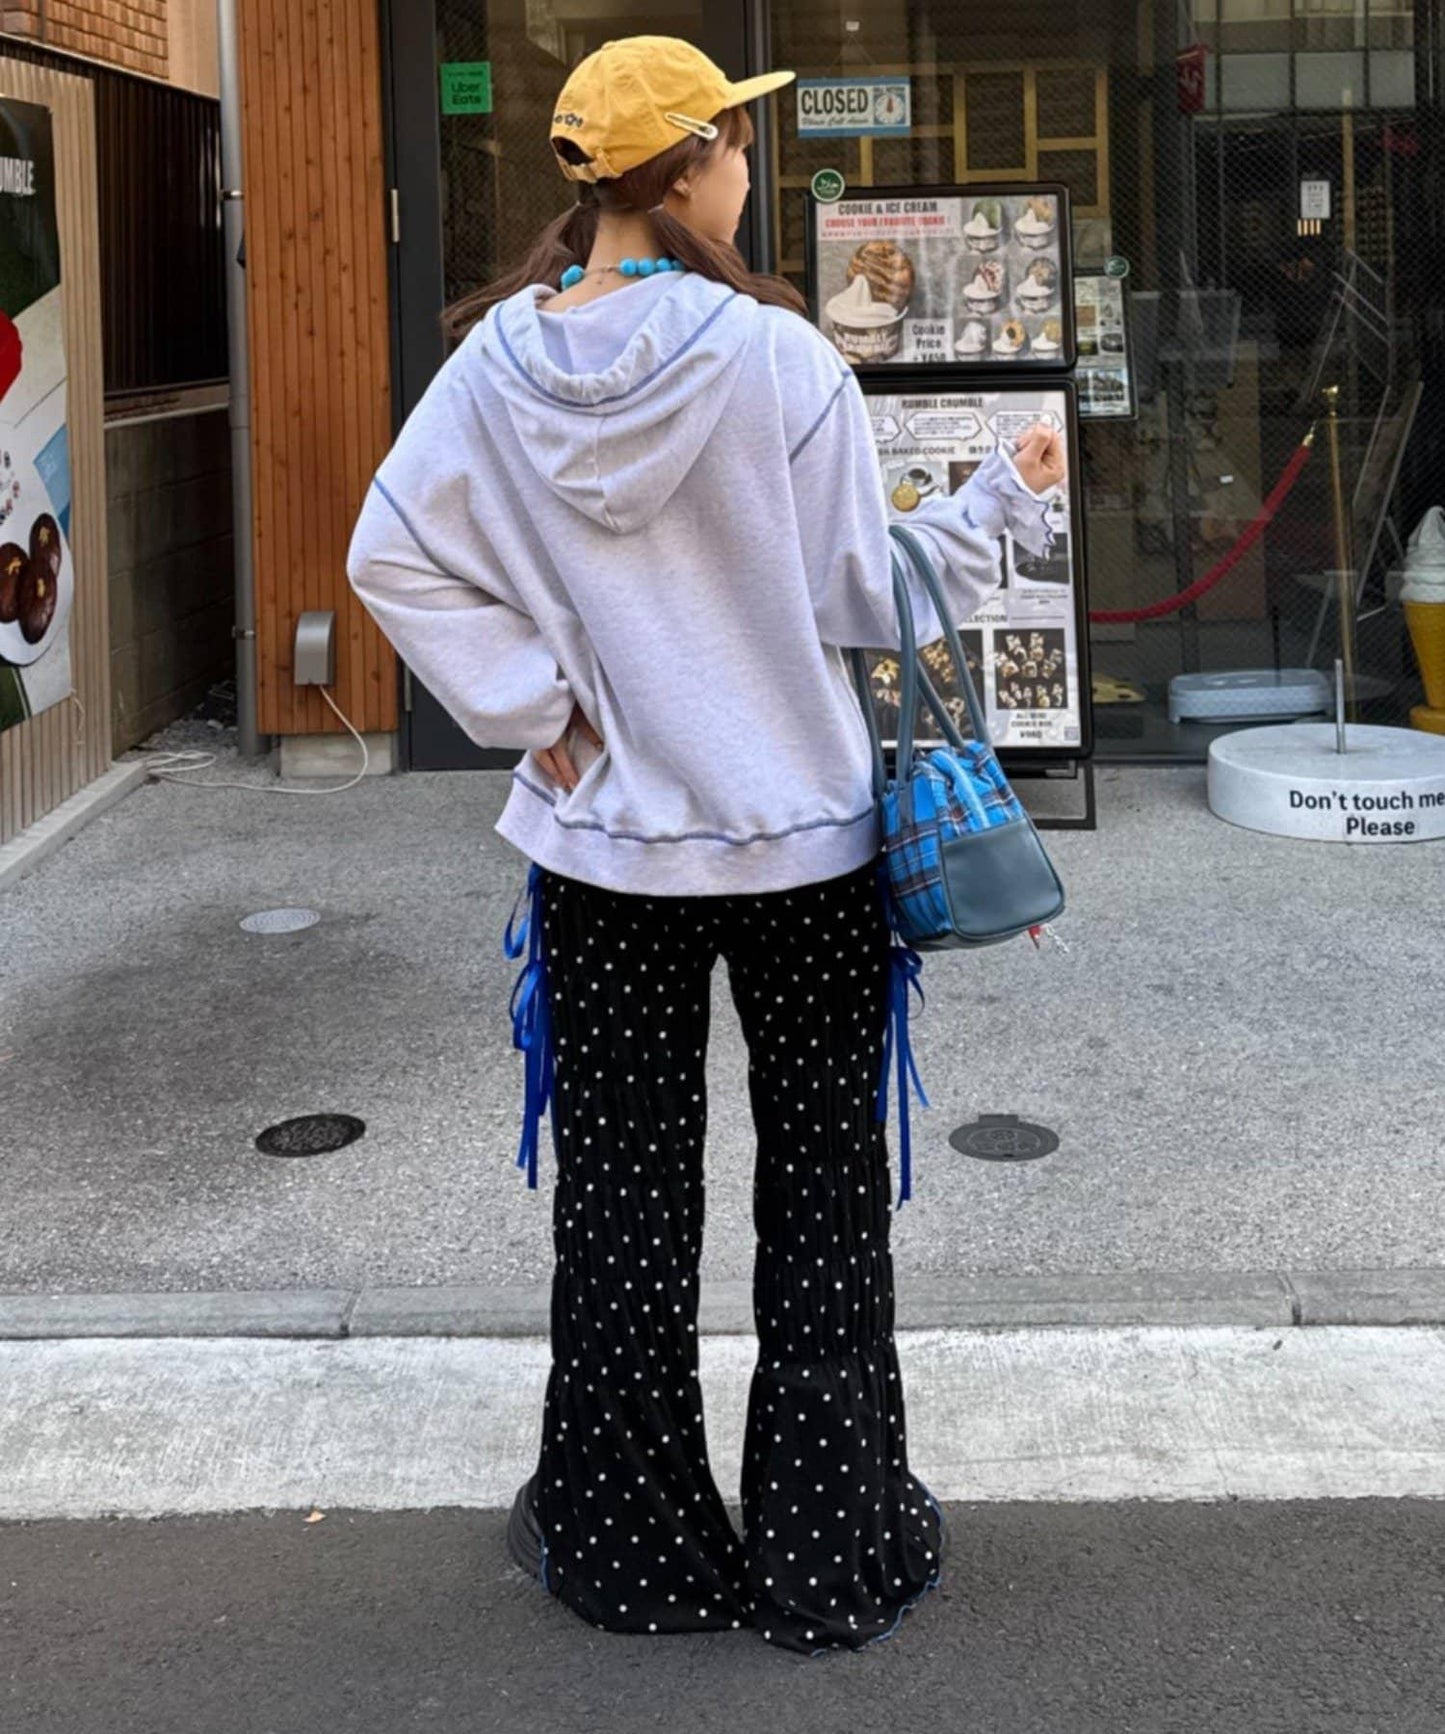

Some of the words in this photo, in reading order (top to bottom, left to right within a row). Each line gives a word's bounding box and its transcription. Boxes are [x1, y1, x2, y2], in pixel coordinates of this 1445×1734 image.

[801, 88, 868, 115] CLOSED
[838, 202, 873, 215] COOKIE
[885, 202, 900, 213] ICE
[903, 200, 938, 213] CREAM
[912, 324, 945, 336] Cookie
[916, 338, 942, 349] Price
[901, 399, 938, 410] RUMBLE
[940, 397, 983, 408] CRUMBLE
[1289, 790, 1348, 810] Don't
[1352, 791, 1414, 810] touch
[1418, 792, 1445, 808] me
[1346, 817, 1415, 836] Please
